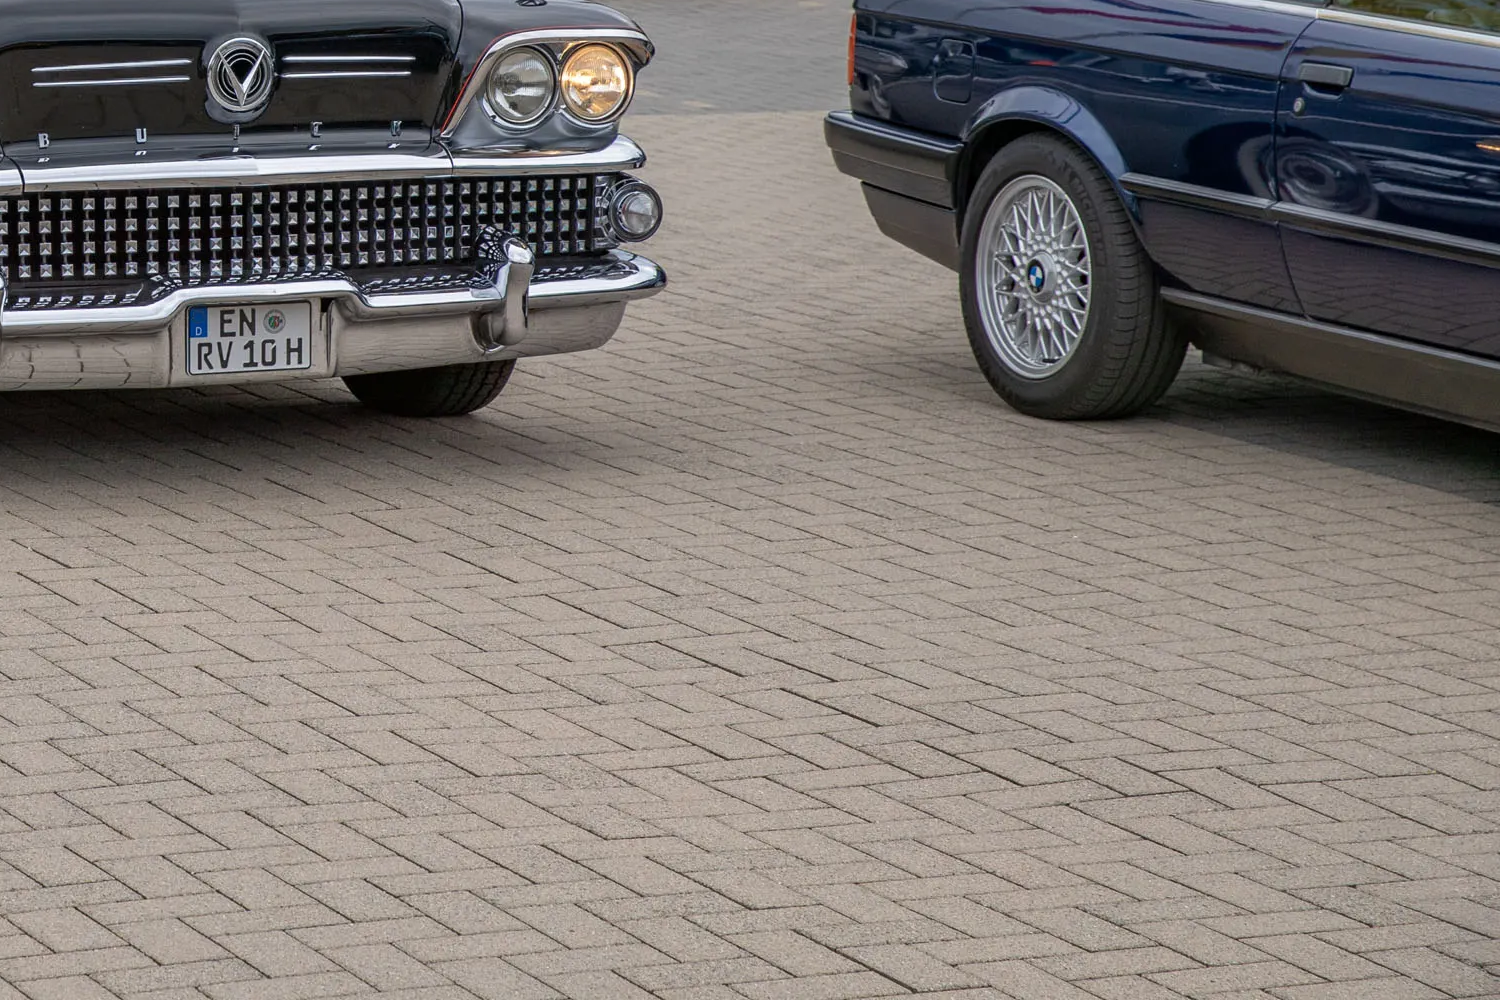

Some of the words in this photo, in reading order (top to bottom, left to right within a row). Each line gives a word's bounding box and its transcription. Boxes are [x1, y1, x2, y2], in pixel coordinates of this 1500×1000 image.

[195, 326, 203, 336] D
[219, 308, 256, 338] EN
[197, 340, 234, 371] RV
